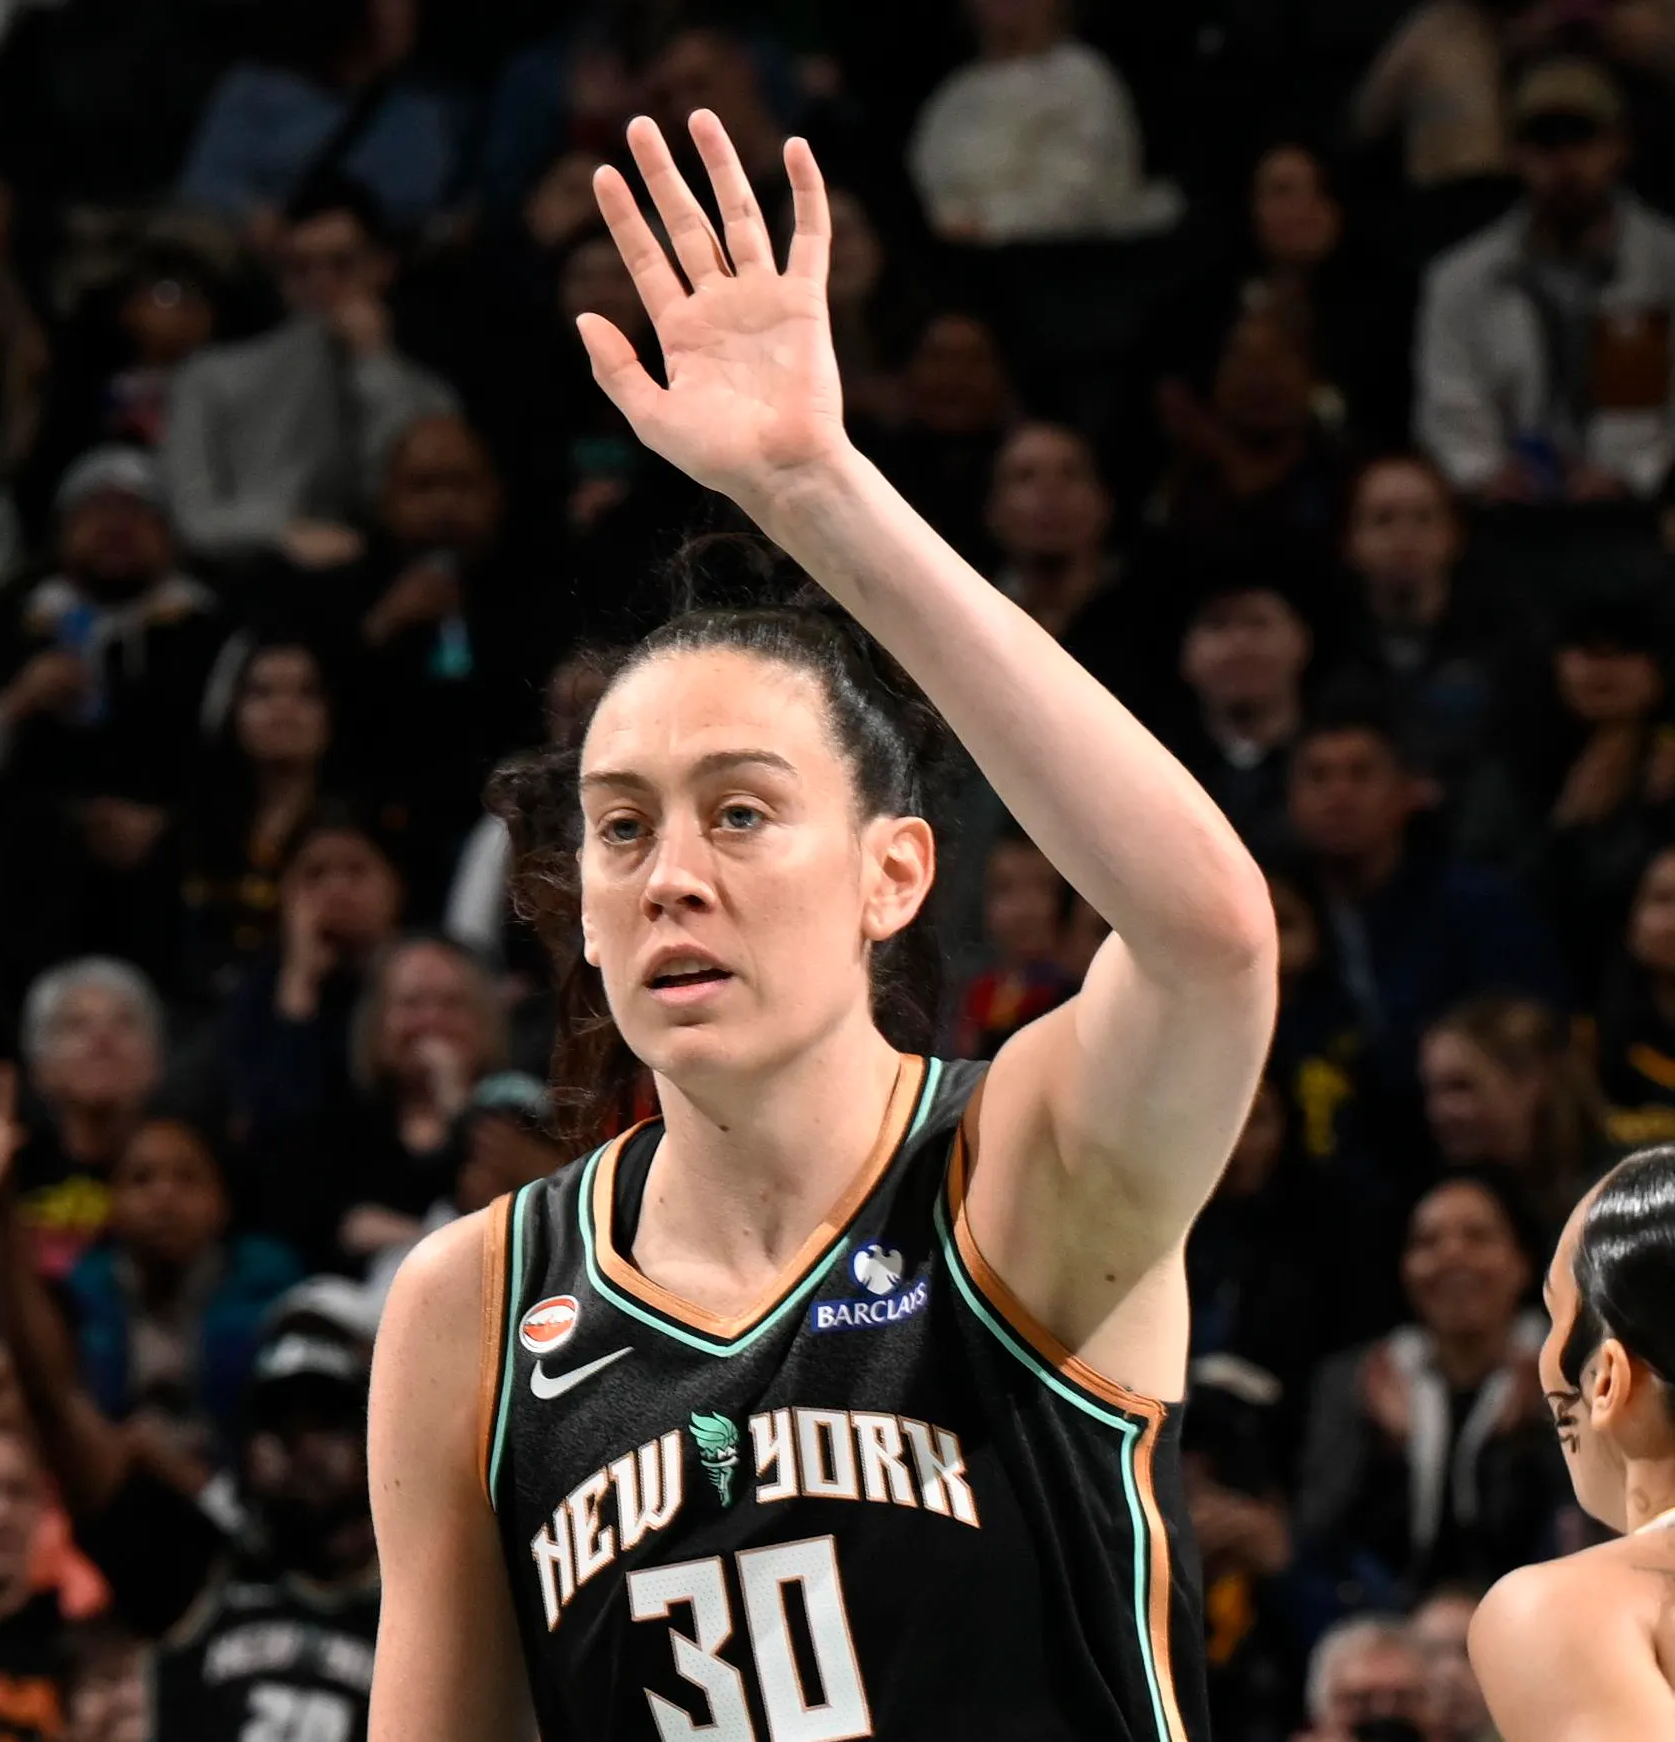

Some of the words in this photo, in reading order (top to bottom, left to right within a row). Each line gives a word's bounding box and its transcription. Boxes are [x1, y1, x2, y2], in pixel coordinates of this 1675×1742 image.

[816, 1281, 927, 1328] BARCLAYS
[530, 1428, 686, 1632] NEW
[748, 1406, 981, 1529] YORK
[625, 1534, 874, 1742] 30
